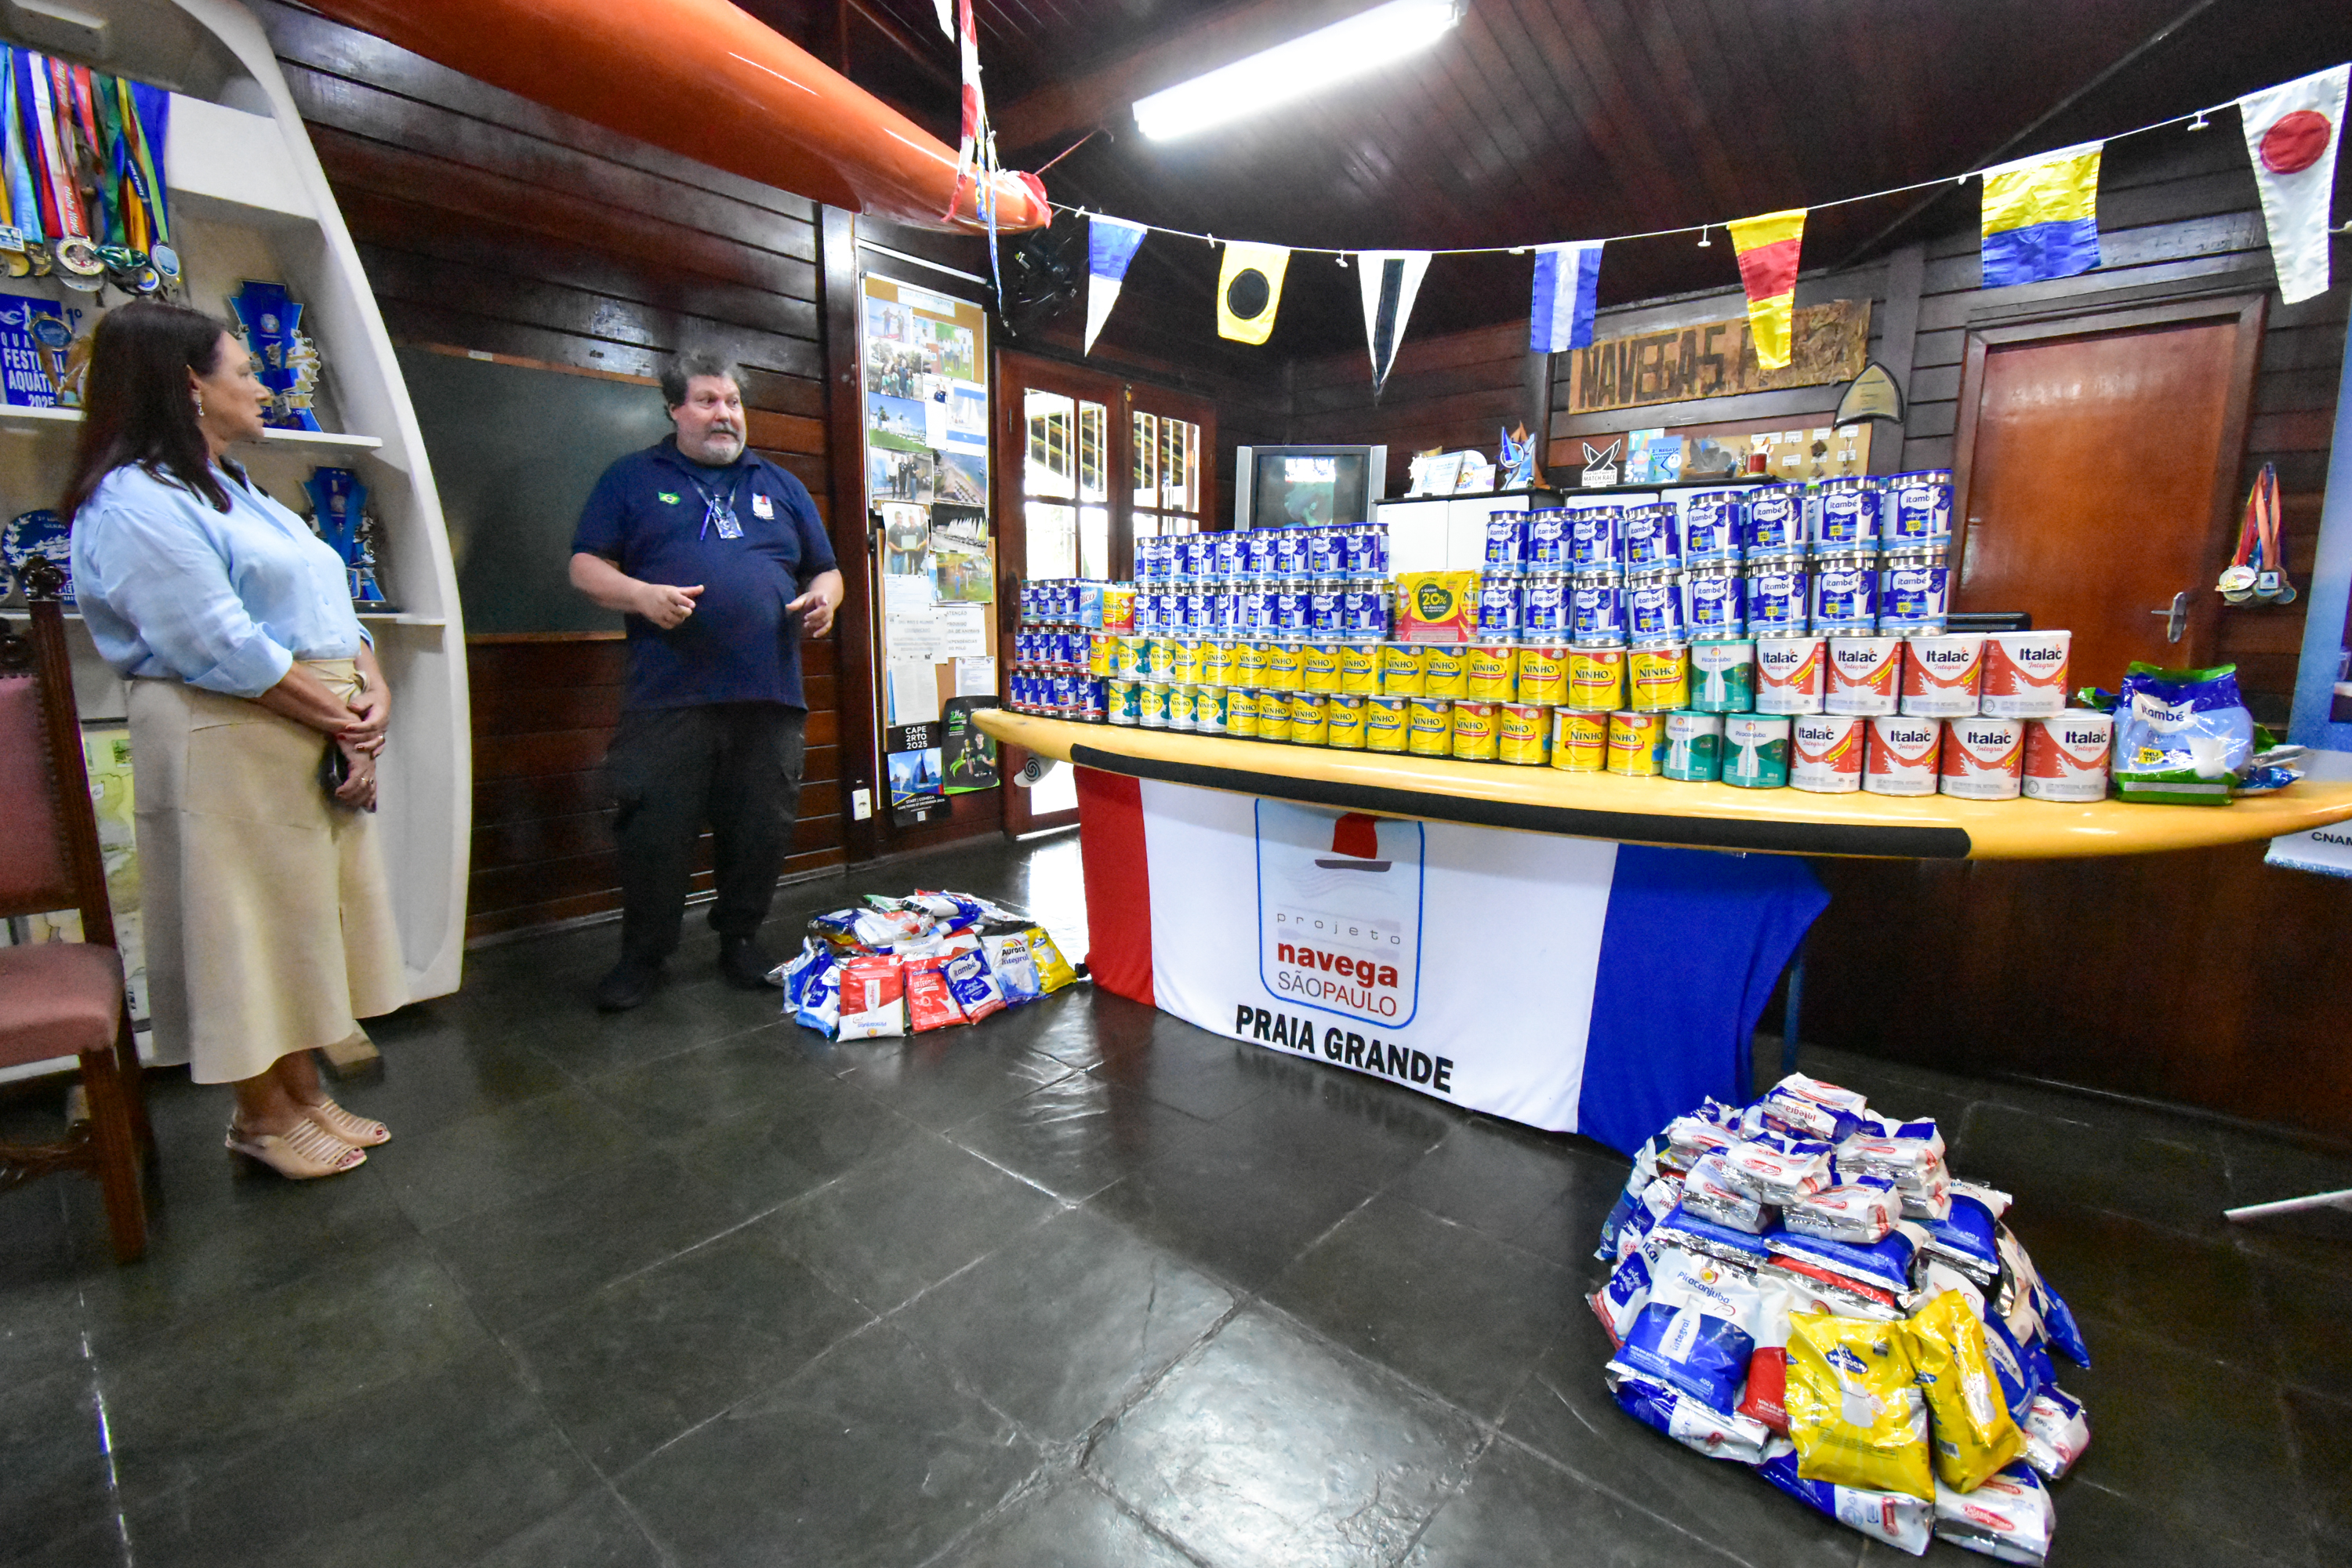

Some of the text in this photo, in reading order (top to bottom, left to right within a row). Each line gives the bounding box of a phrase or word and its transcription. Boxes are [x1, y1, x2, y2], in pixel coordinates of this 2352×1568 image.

[3, 347, 65, 373] FESTIL
[9, 369, 68, 393] AQUÁTI
[1830, 500, 1857, 509] itambé
[1757, 506, 1782, 516] itambé
[1691, 512, 1713, 521] itambé
[1765, 580, 1791, 590] itambé
[1826, 576, 1853, 586] itambé
[1897, 575, 1927, 586] itambé
[1697, 584, 1722, 594] itambé
[1638, 593, 1661, 604] itambé
[1240, 655, 1262, 663] NINHO
[1762, 651, 1798, 663] Italac
[1838, 650, 1878, 662] Italac
[1926, 649, 1969, 662] Italac
[2020, 648, 2062, 661] Italac
[1388, 659, 1414, 669] NINHO
[1428, 661, 1455, 670] NINHO
[1472, 662, 1501, 672] NINHO
[1524, 665, 1555, 673] NINHO
[1575, 670, 1609, 679] NINHO
[1639, 667, 1676, 678] NINHO
[1262, 706, 1287, 715] NINHO
[1294, 710, 1317, 718] NINHO
[2141, 703, 2185, 722] itambé
[1330, 712, 1352, 720] NINHO
[1370, 713, 1395, 723] NINHO
[1414, 716, 1440, 726] NINHO
[1456, 720, 1483, 730] NINHO
[1502, 723, 1529, 733] NINHO
[906, 726, 927, 735] CAPE
[1798, 727, 1834, 740] Italac
[1570, 731, 1603, 741] NINHO
[1609, 731, 1637, 742] NINHO
[1890, 730, 1931, 742] Italac
[1967, 731, 2012, 745] Italac
[2065, 731, 2107, 744] Italac
[907, 741, 928, 750] 2025
[1276, 911, 1401, 946] projeto
[1002, 946, 1026, 956] Aurora
[1277, 942, 1399, 989] navega
[1236, 1004, 1454, 1094] PRAIA GRANDE
[1642, 1242, 1660, 1265] ita
[1677, 1270, 1731, 1305] Piracanjuba
[1669, 1318, 1691, 1351] integral
[1700, 1377, 1710, 1387] 400
